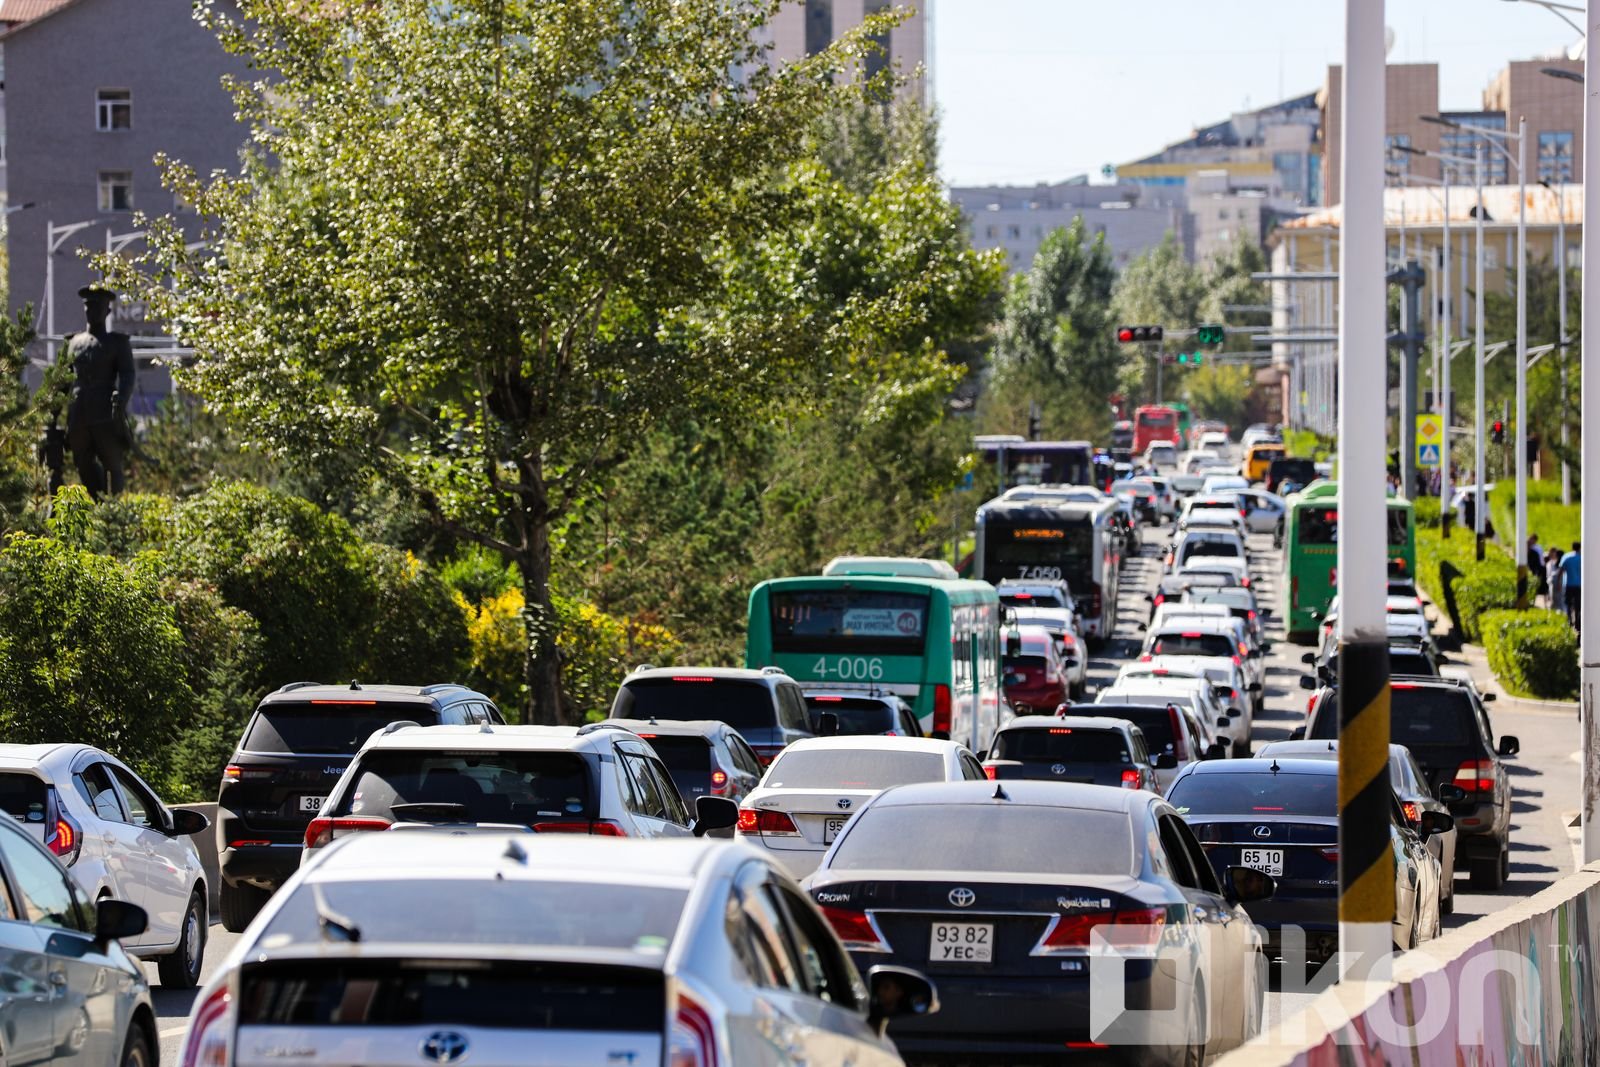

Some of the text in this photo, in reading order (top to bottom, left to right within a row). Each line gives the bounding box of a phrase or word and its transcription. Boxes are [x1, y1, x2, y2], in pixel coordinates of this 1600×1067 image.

[899, 617, 915, 628] 40
[812, 657, 883, 679] 4-006
[305, 797, 320, 810] 38
[829, 821, 842, 831] 95
[1244, 851, 1280, 864] 65 10
[817, 892, 850, 902] CROWN
[937, 926, 988, 944] 93 82
[943, 946, 974, 959] УЕС
